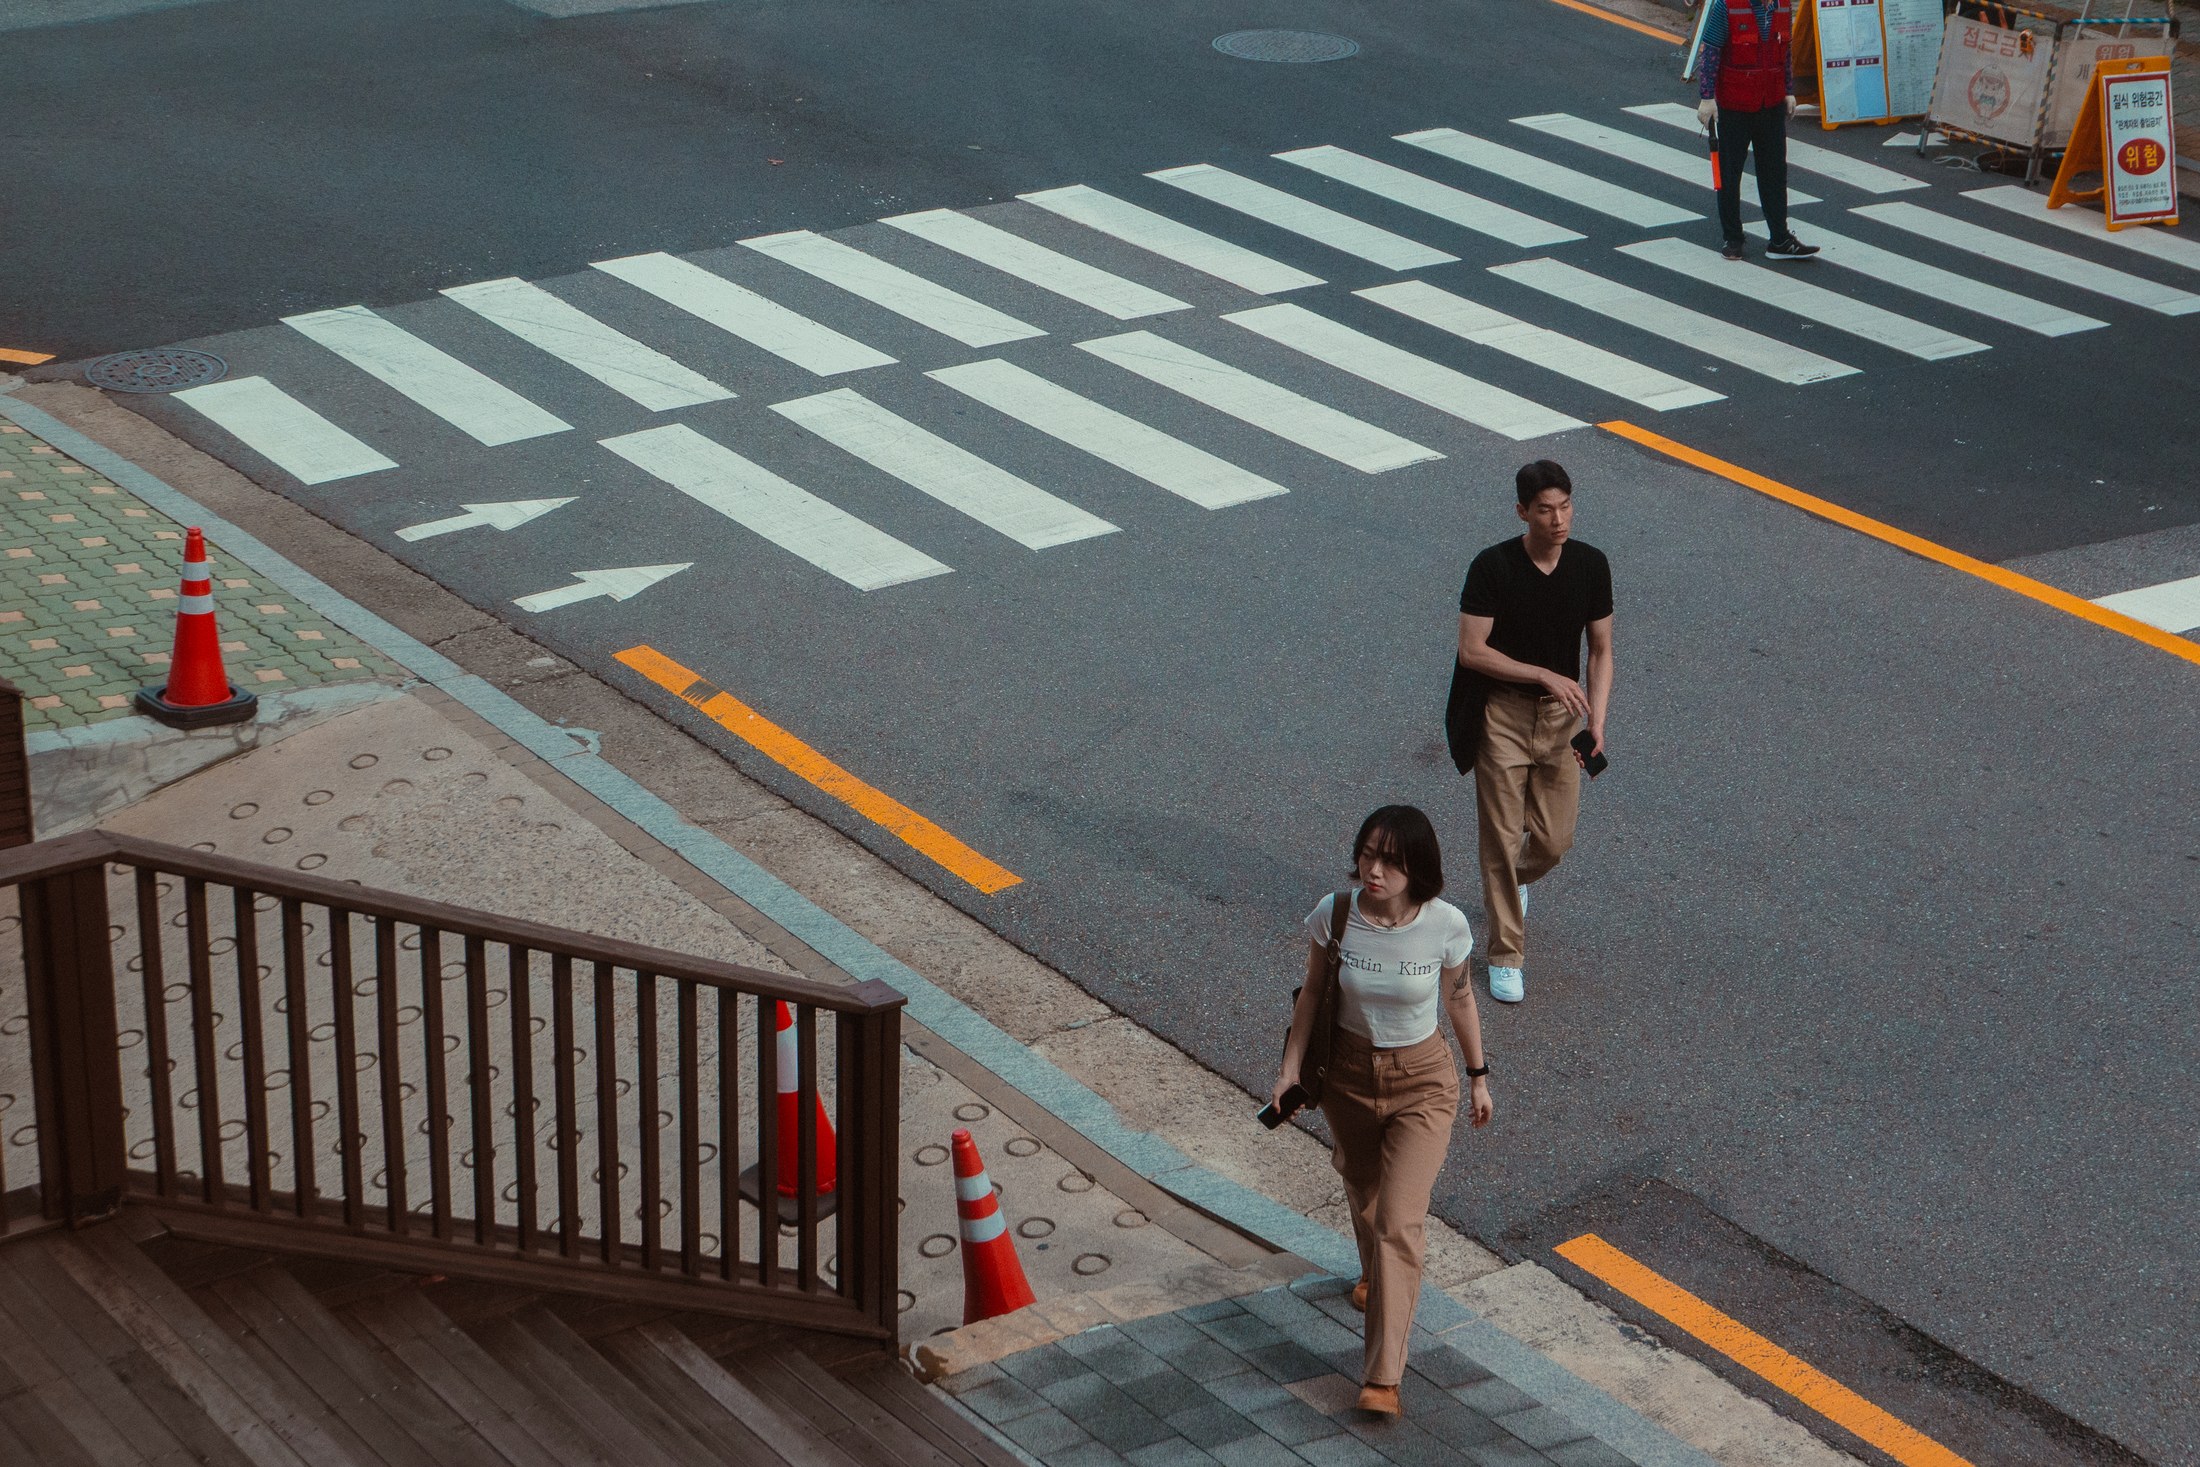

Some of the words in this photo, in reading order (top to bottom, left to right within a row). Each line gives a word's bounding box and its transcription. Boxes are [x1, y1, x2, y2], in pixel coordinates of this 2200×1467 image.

[2113, 92, 2129, 110] 질식
[2131, 90, 2163, 108] 위험공간
[2126, 144, 2158, 168] 위험
[1398, 961, 1432, 976] Kim
